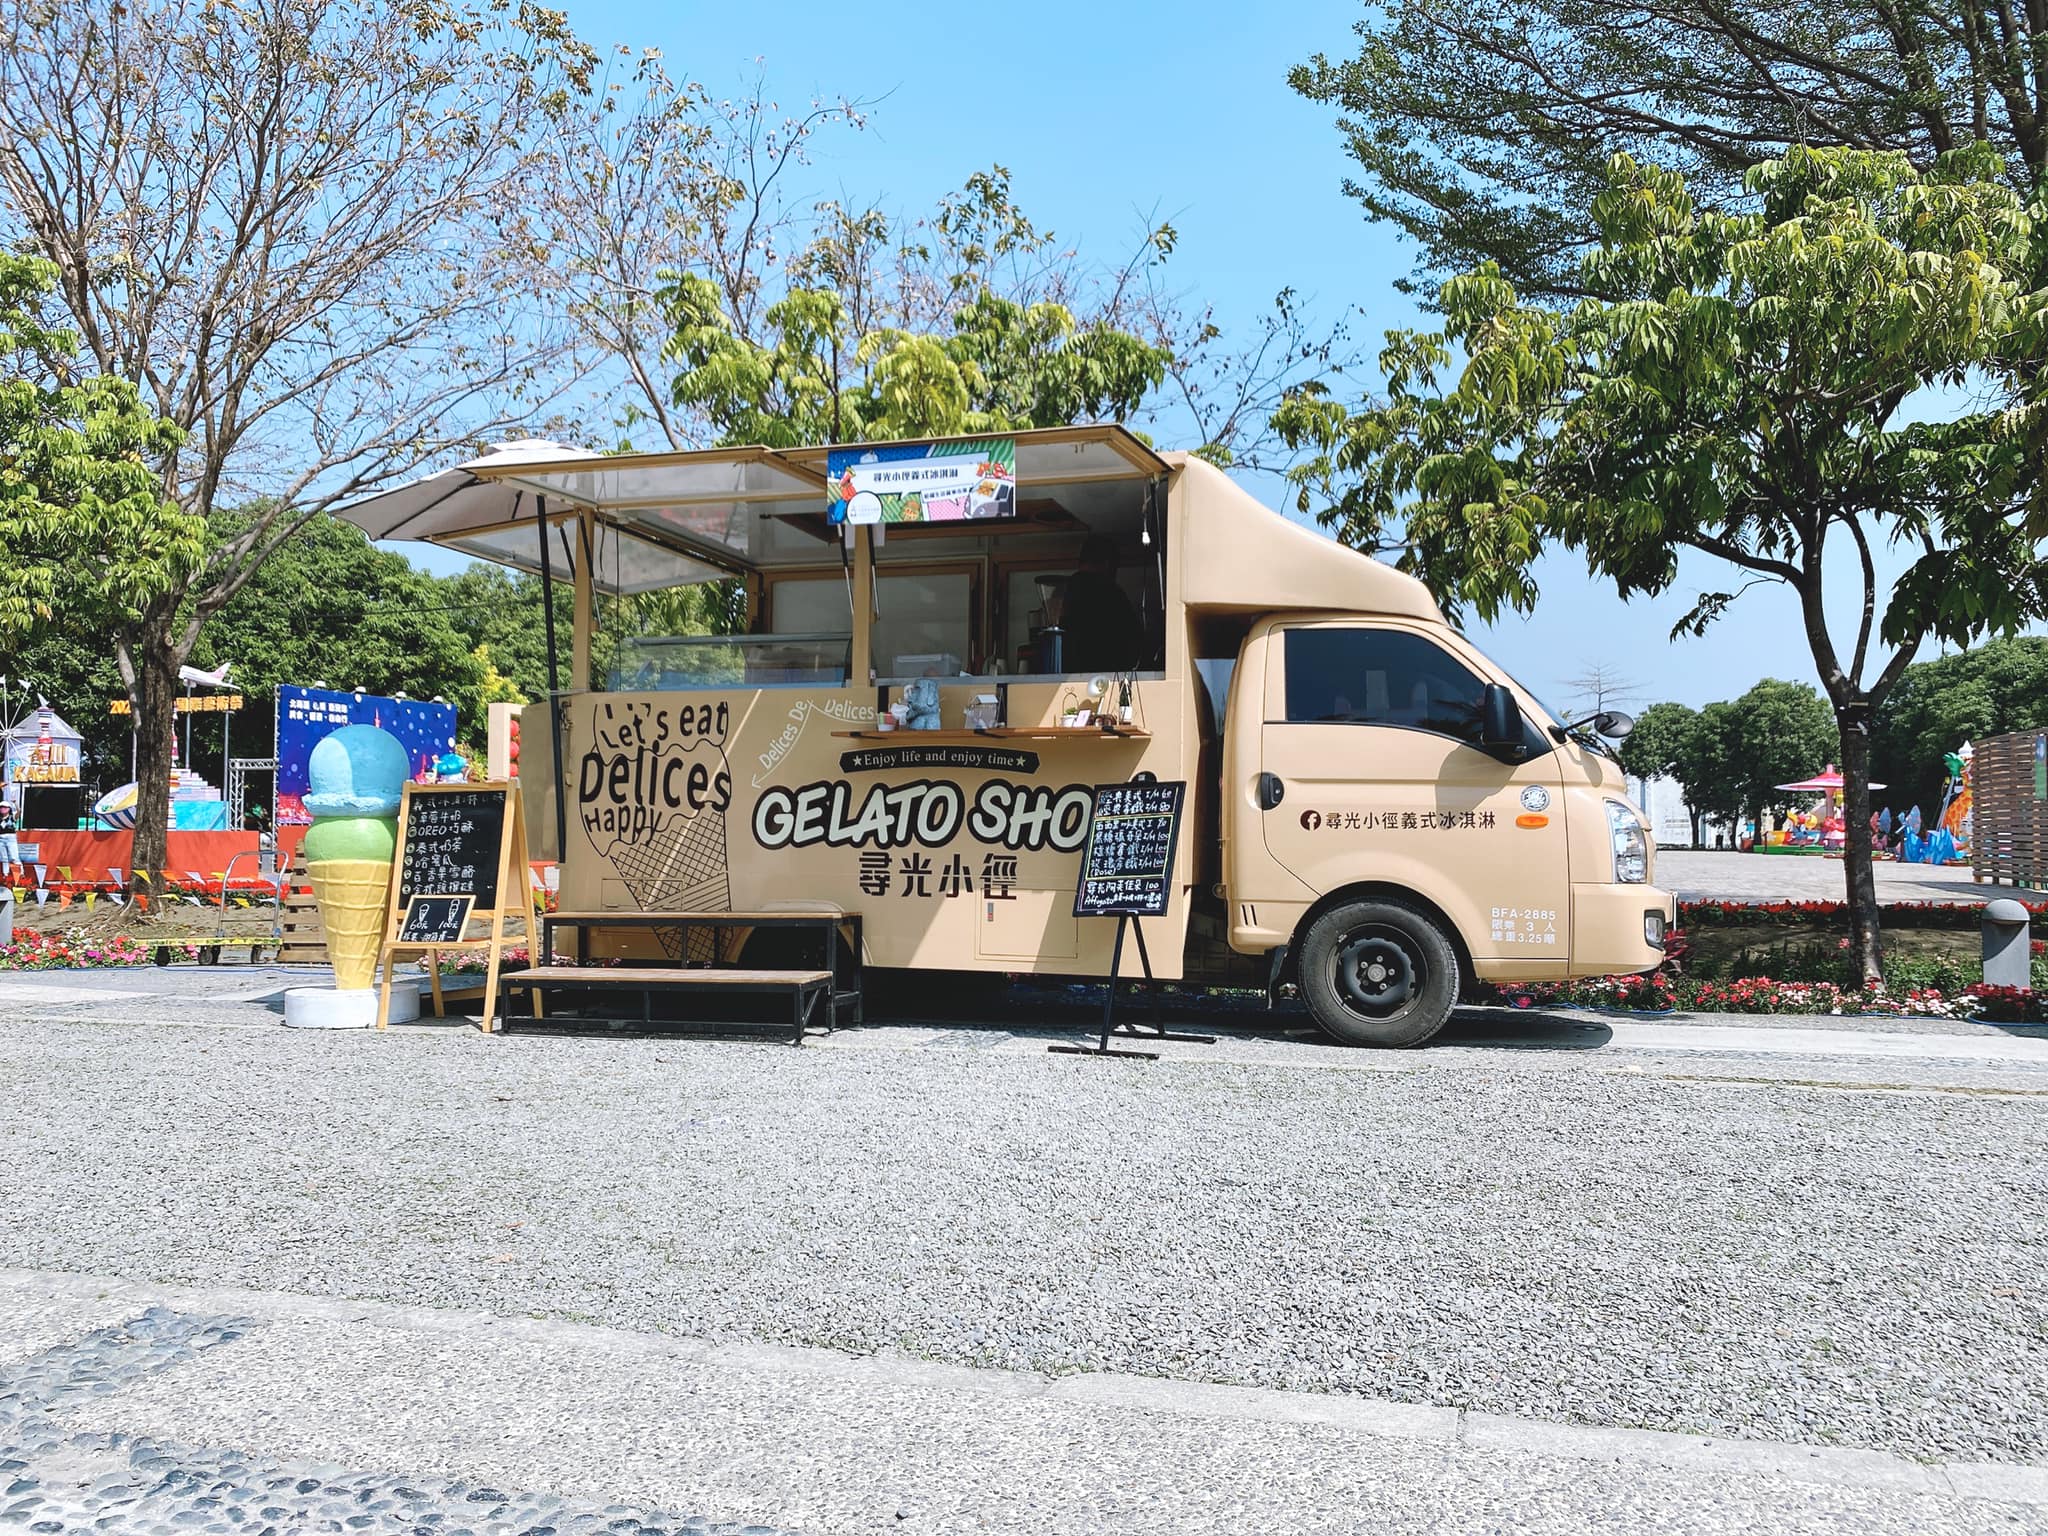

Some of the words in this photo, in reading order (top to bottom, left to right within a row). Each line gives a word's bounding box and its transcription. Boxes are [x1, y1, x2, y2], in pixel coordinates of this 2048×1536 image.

[680, 701, 727, 737] eat
[823, 699, 874, 720] Delices
[759, 723, 799, 770] Delices
[864, 753, 897, 767] Enjoy
[901, 750, 921, 762] life
[925, 750, 946, 761] and
[951, 751, 983, 766] enjoy
[987, 752, 1014, 766] time
[579, 745, 732, 812] Delices
[584, 805, 662, 845] Happy
[753, 781, 964, 848] GELATO
[1326, 811, 1496, 830] 尋光小徑義式冰淇淋
[418, 825, 447, 836] OREO
[858, 851, 1018, 900] 尋光小徑
[1491, 907, 1556, 920] BFA-2885
[1526, 921, 1534, 931] 3
[1544, 921, 1556, 932] 人
